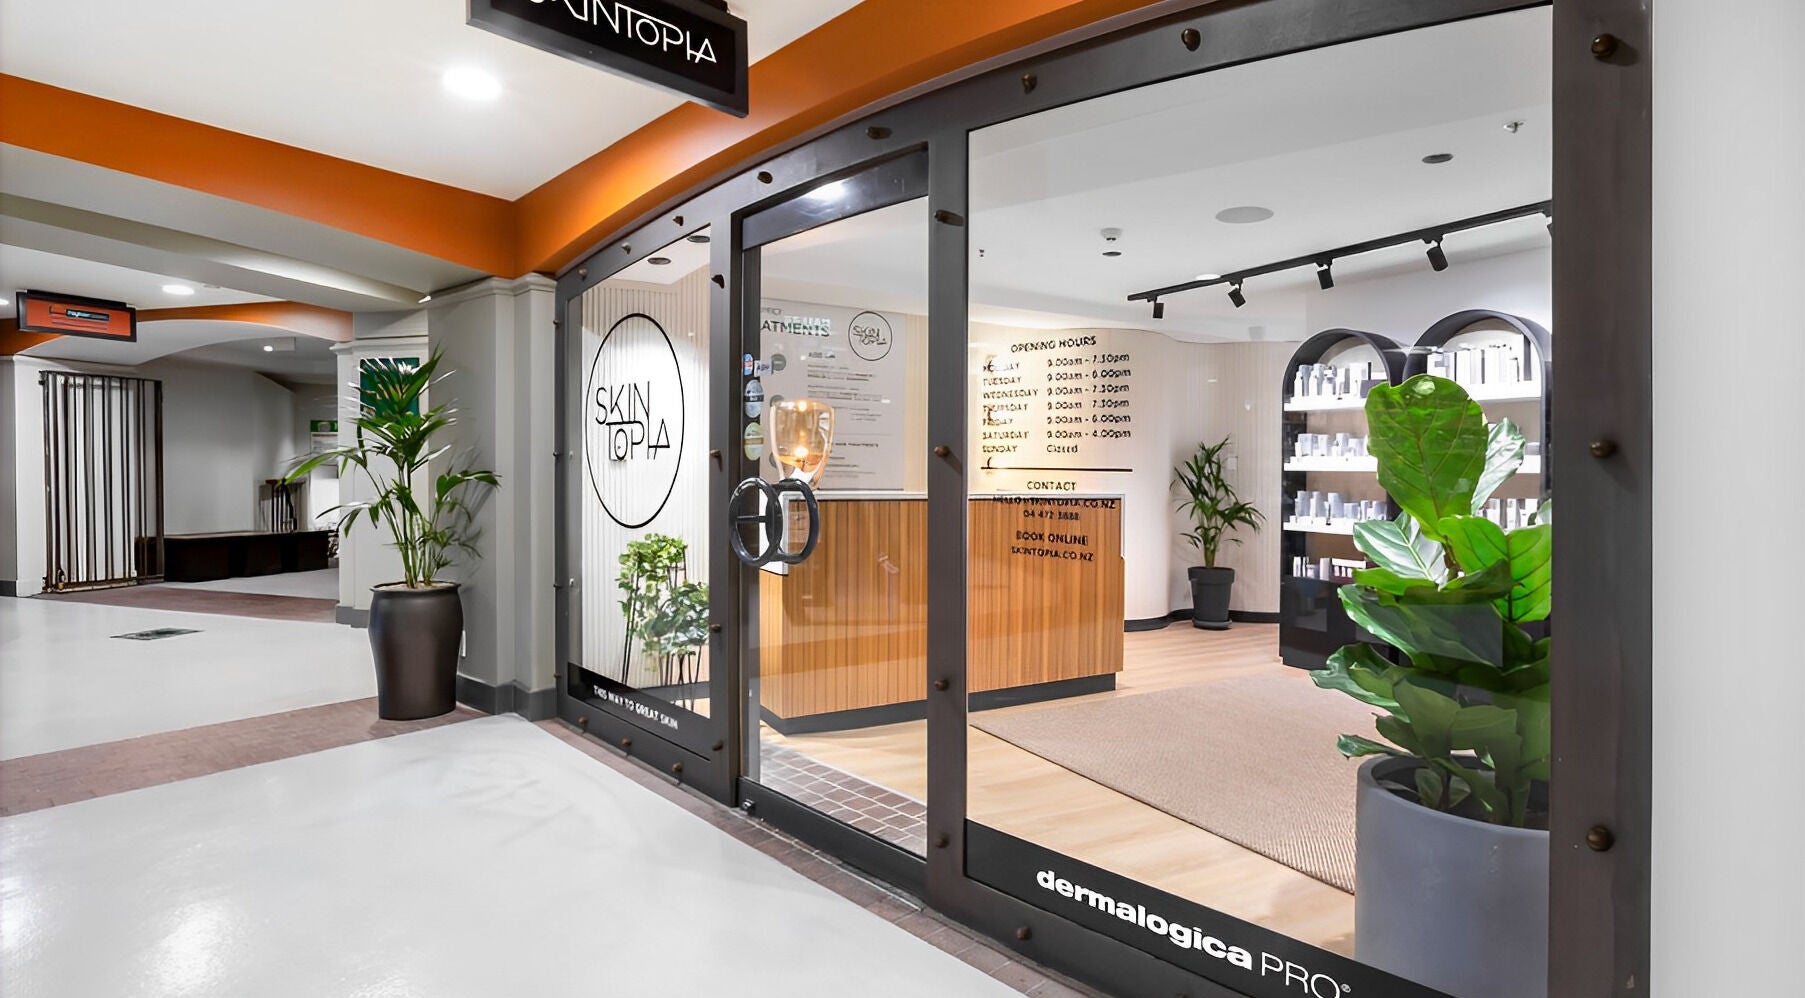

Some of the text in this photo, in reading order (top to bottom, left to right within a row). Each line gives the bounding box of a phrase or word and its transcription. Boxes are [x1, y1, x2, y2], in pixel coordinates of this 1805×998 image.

[530, 0, 717, 63] INTOPIA
[1011, 335, 1097, 353] OPENING HOURS
[983, 376, 1021, 386] TUESDAY
[983, 389, 1039, 399] WEDNESDAY
[595, 381, 650, 425] SKIN
[606, 418, 671, 461] TOPIA
[982, 430, 1029, 440] SATURDAY
[982, 444, 1078, 453] SUNDAY Closed
[1026, 481, 1077, 492] CONTACT
[1023, 509, 1035, 518] 04
[1016, 530, 1088, 546] BOOK ONLINE
[593, 685, 608, 700] THIS
[608, 691, 624, 707] WAY
[624, 698, 635, 712] TO
[635, 702, 660, 721] GREAT
[1036, 869, 1253, 971] dermalogica
